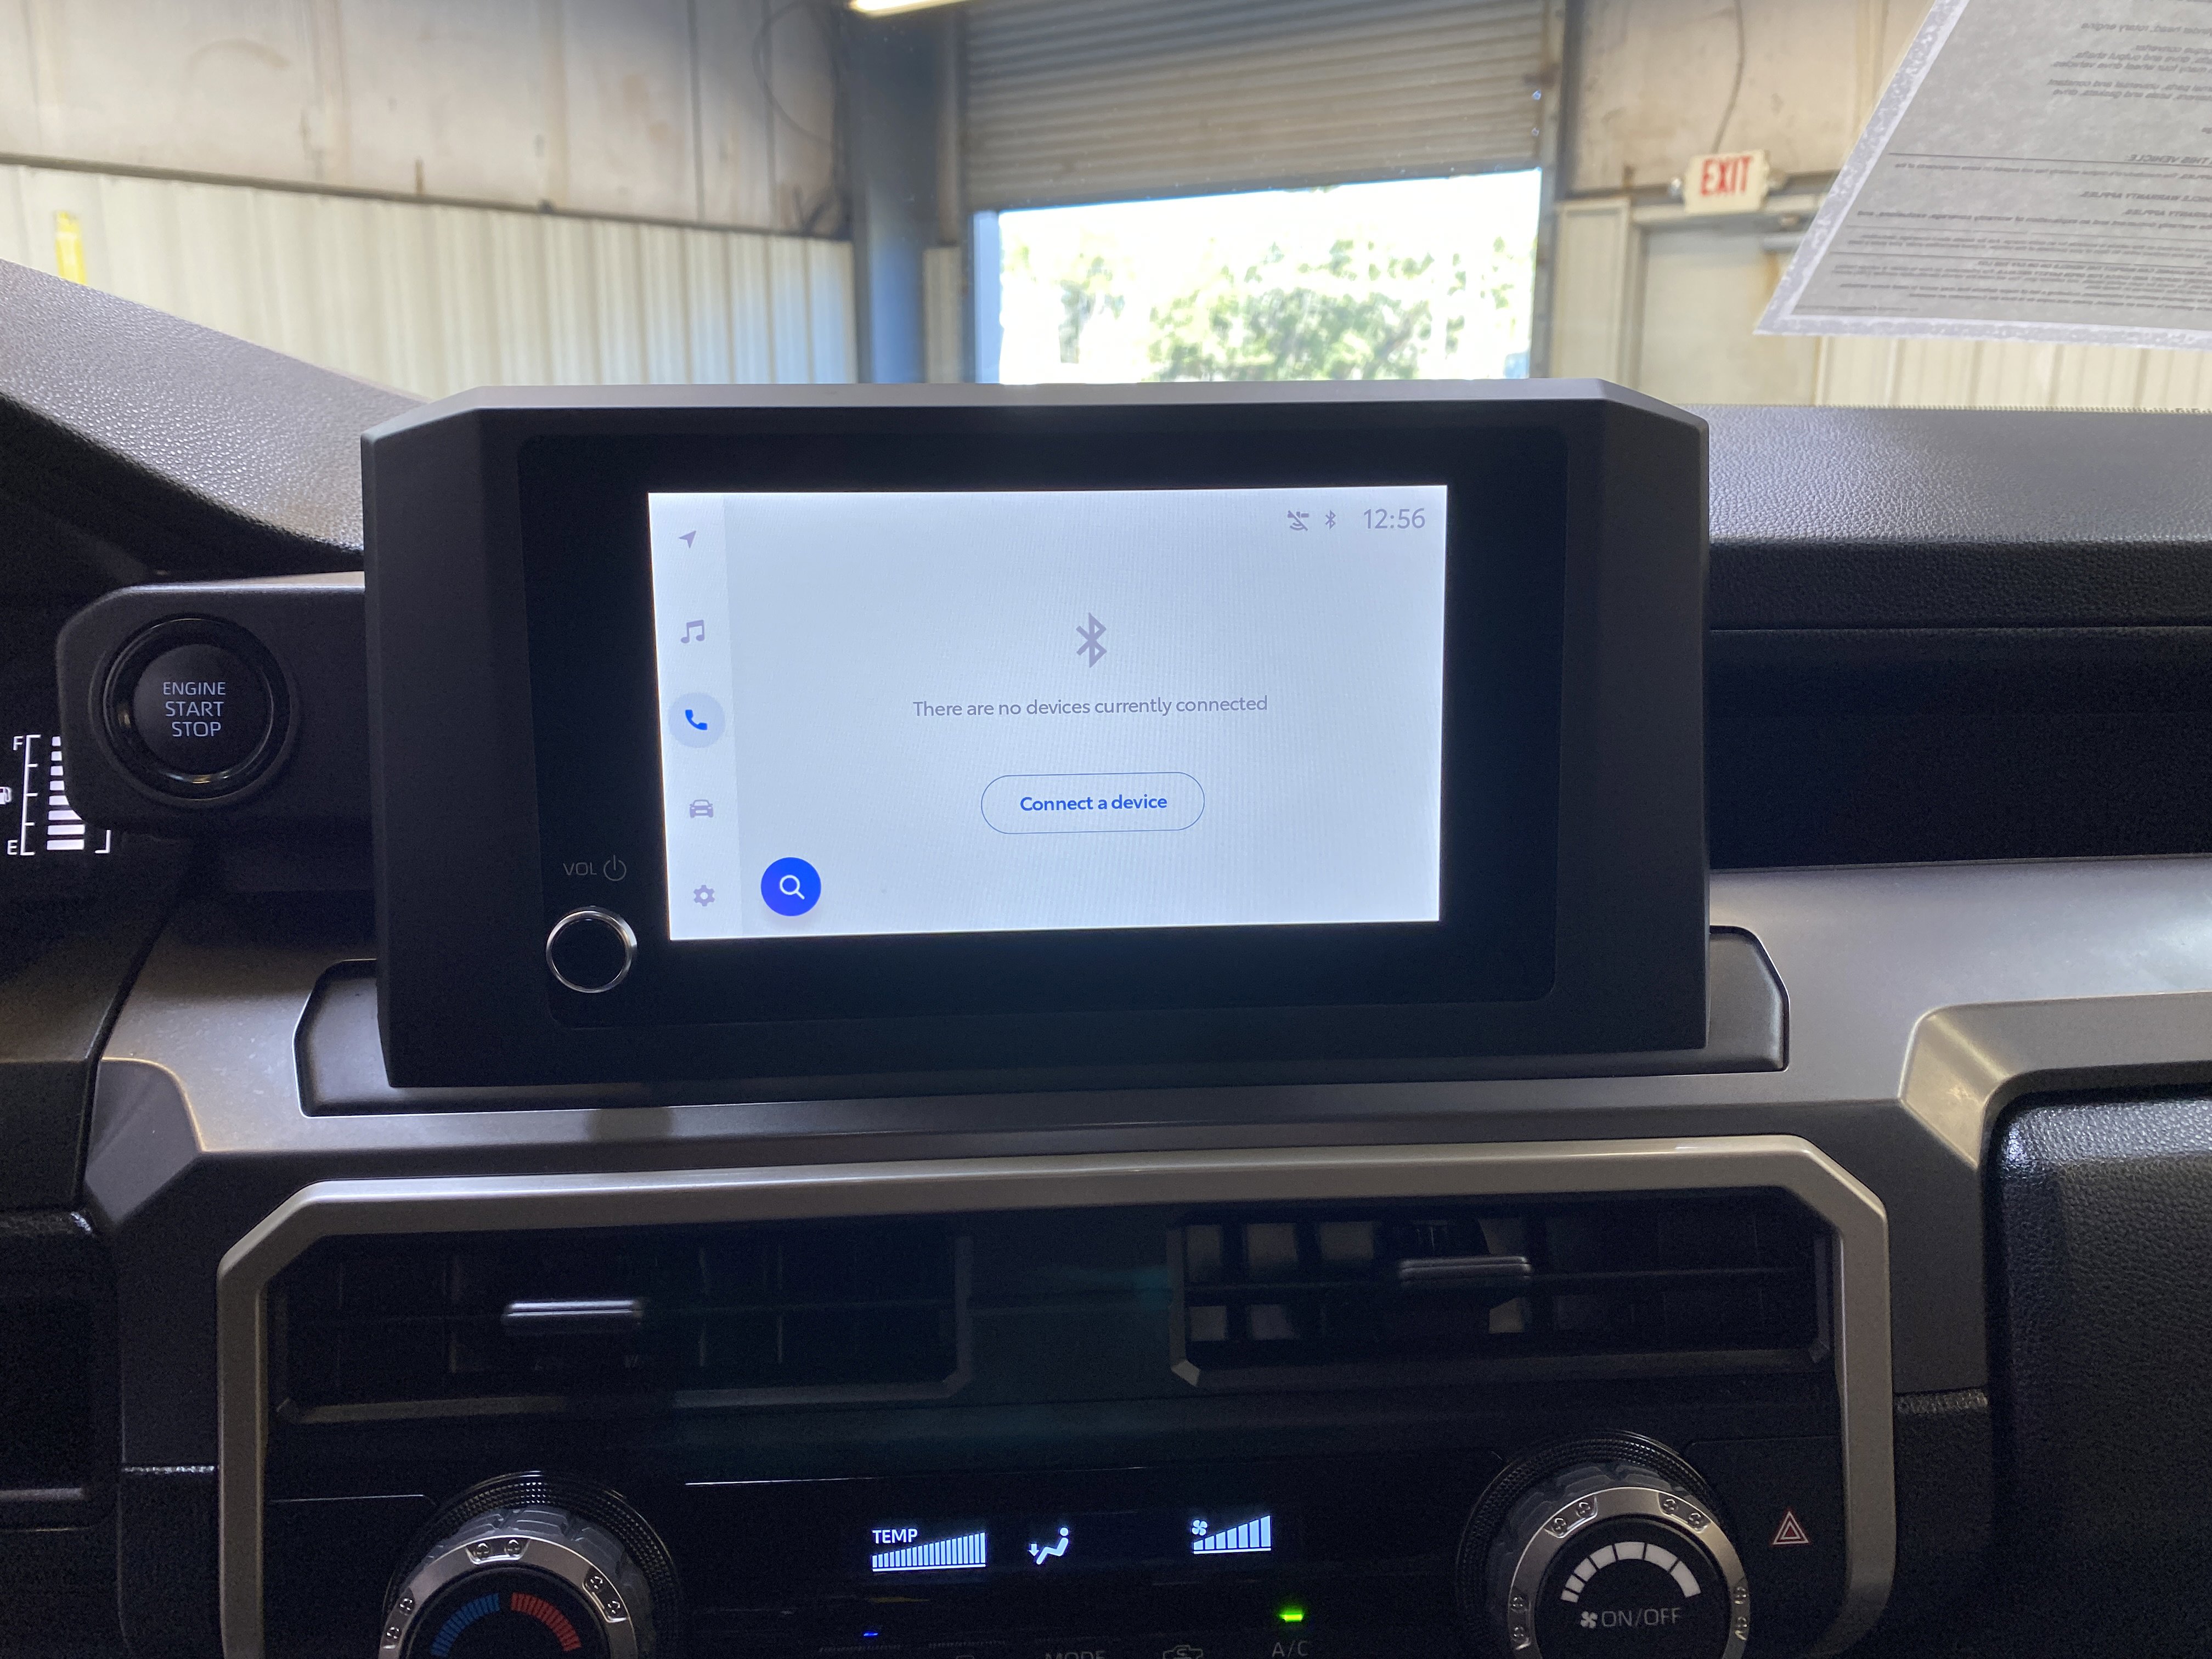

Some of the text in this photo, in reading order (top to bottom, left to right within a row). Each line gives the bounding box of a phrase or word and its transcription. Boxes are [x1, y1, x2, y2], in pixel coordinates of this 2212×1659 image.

[1700, 155, 1753, 197] EXIT
[1363, 507, 1425, 529] 12:56
[163, 681, 226, 695] ENGINE
[165, 701, 224, 716] START
[912, 695, 1268, 716] There are no devices currently connected
[172, 721, 221, 737] STOP
[13, 736, 24, 751] F
[1020, 794, 1167, 811] Connect a device
[7, 839, 18, 855] E
[563, 862, 597, 876] VOL
[872, 1528, 918, 1544] TEMP
[1601, 1607, 1681, 1628] ON/OFF
[1271, 1640, 1310, 1658] A/C
